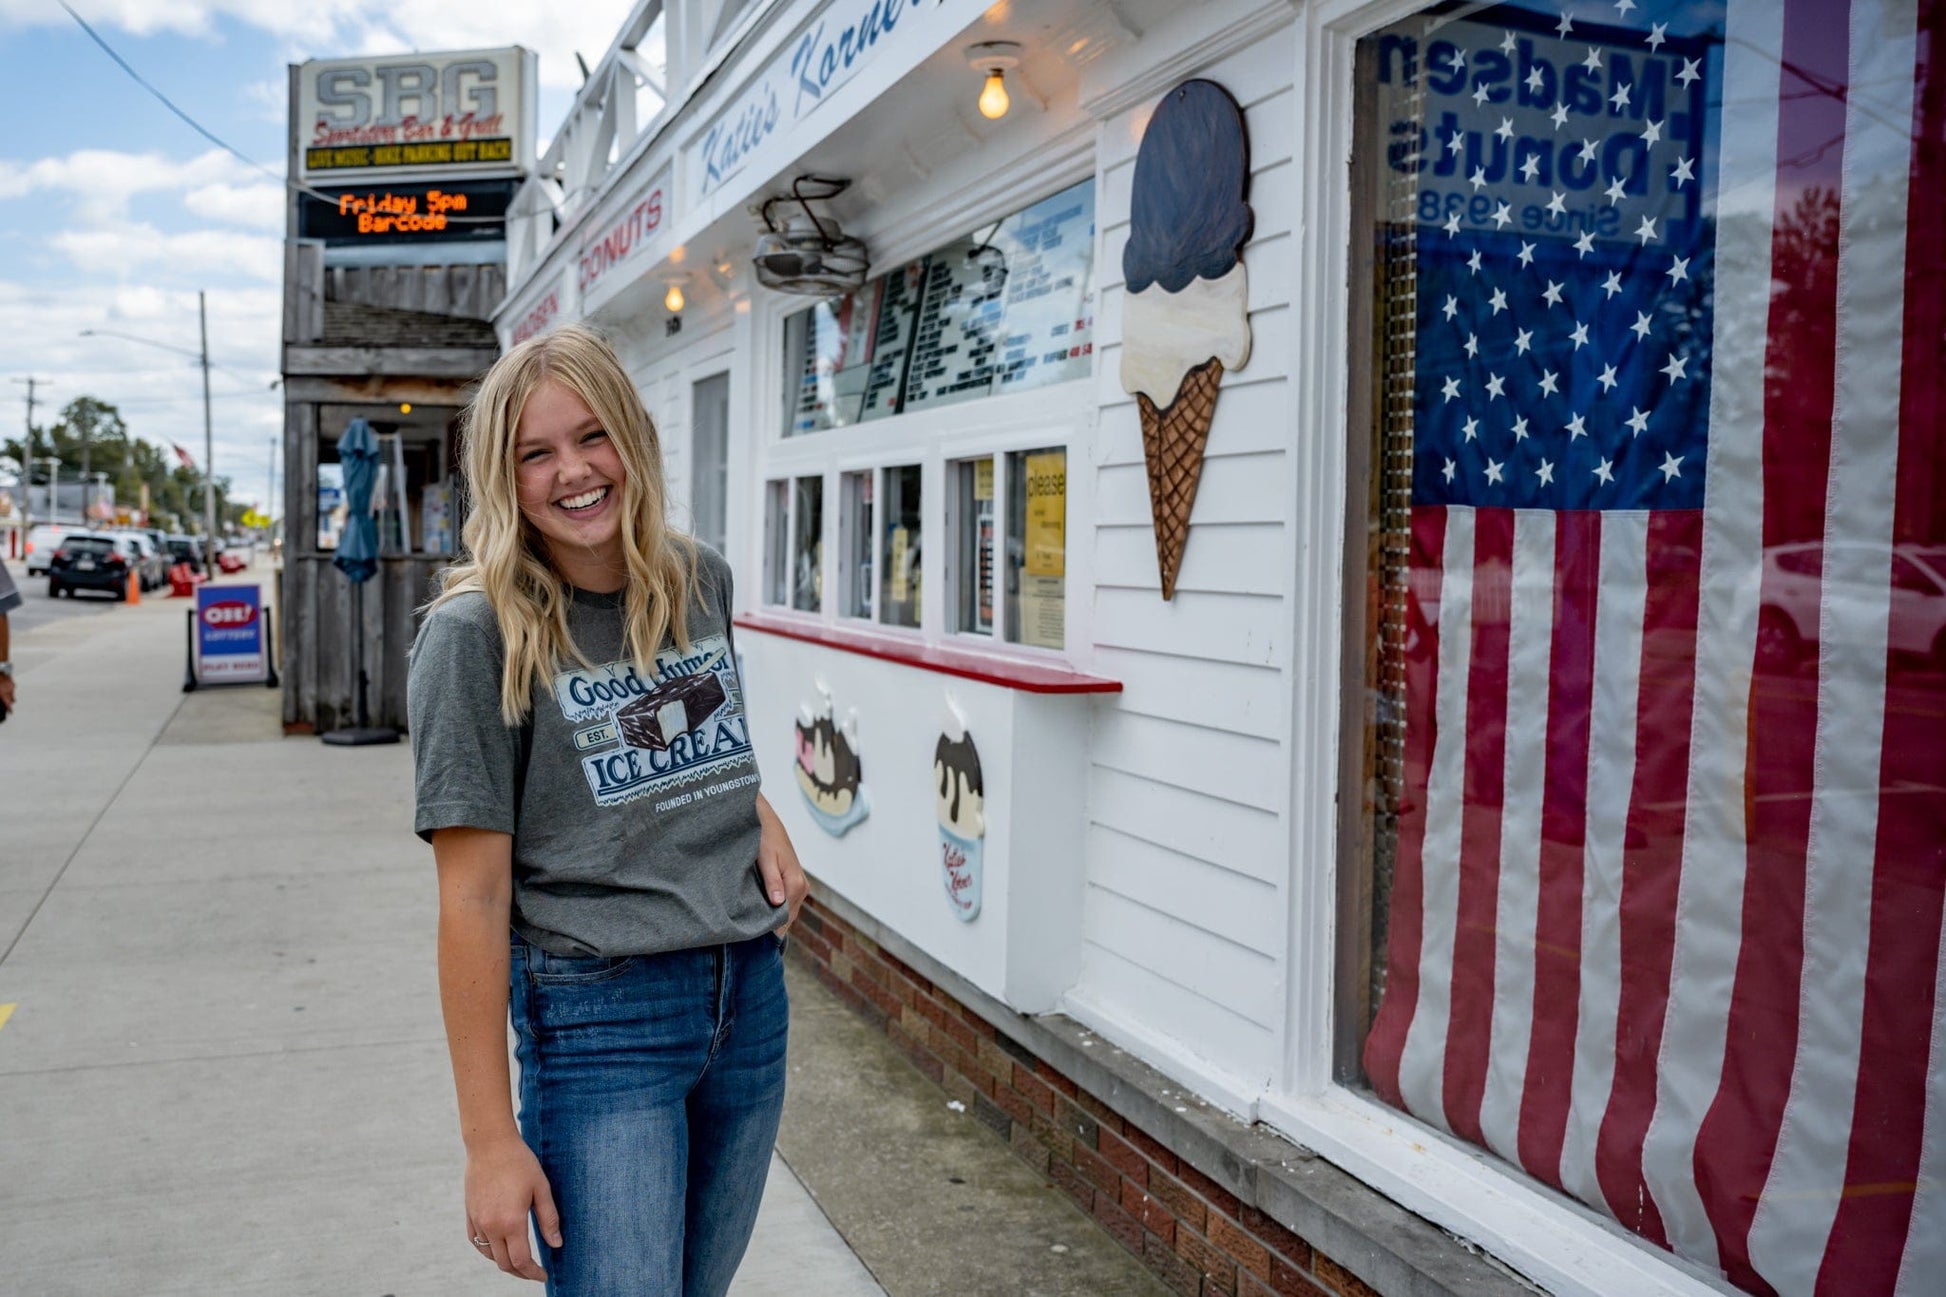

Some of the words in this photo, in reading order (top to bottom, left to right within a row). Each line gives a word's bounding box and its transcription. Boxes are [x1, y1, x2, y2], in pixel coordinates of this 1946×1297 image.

[316, 60, 498, 127] SBG
[701, 82, 780, 194] Katie's
[791, 0, 918, 118] Korne
[402, 115, 434, 141] Bar
[458, 112, 503, 143] Grill
[479, 139, 511, 160] BACK
[339, 192, 416, 215] Friday
[358, 212, 447, 233] Barcode
[580, 189, 662, 291] DONUTS
[1027, 470, 1064, 502] please
[569, 667, 648, 706] Good
[586, 729, 609, 743] EST.
[591, 750, 642, 787] ICE
[655, 794, 692, 813] FOUNDED
[693, 790, 703, 801] IN
